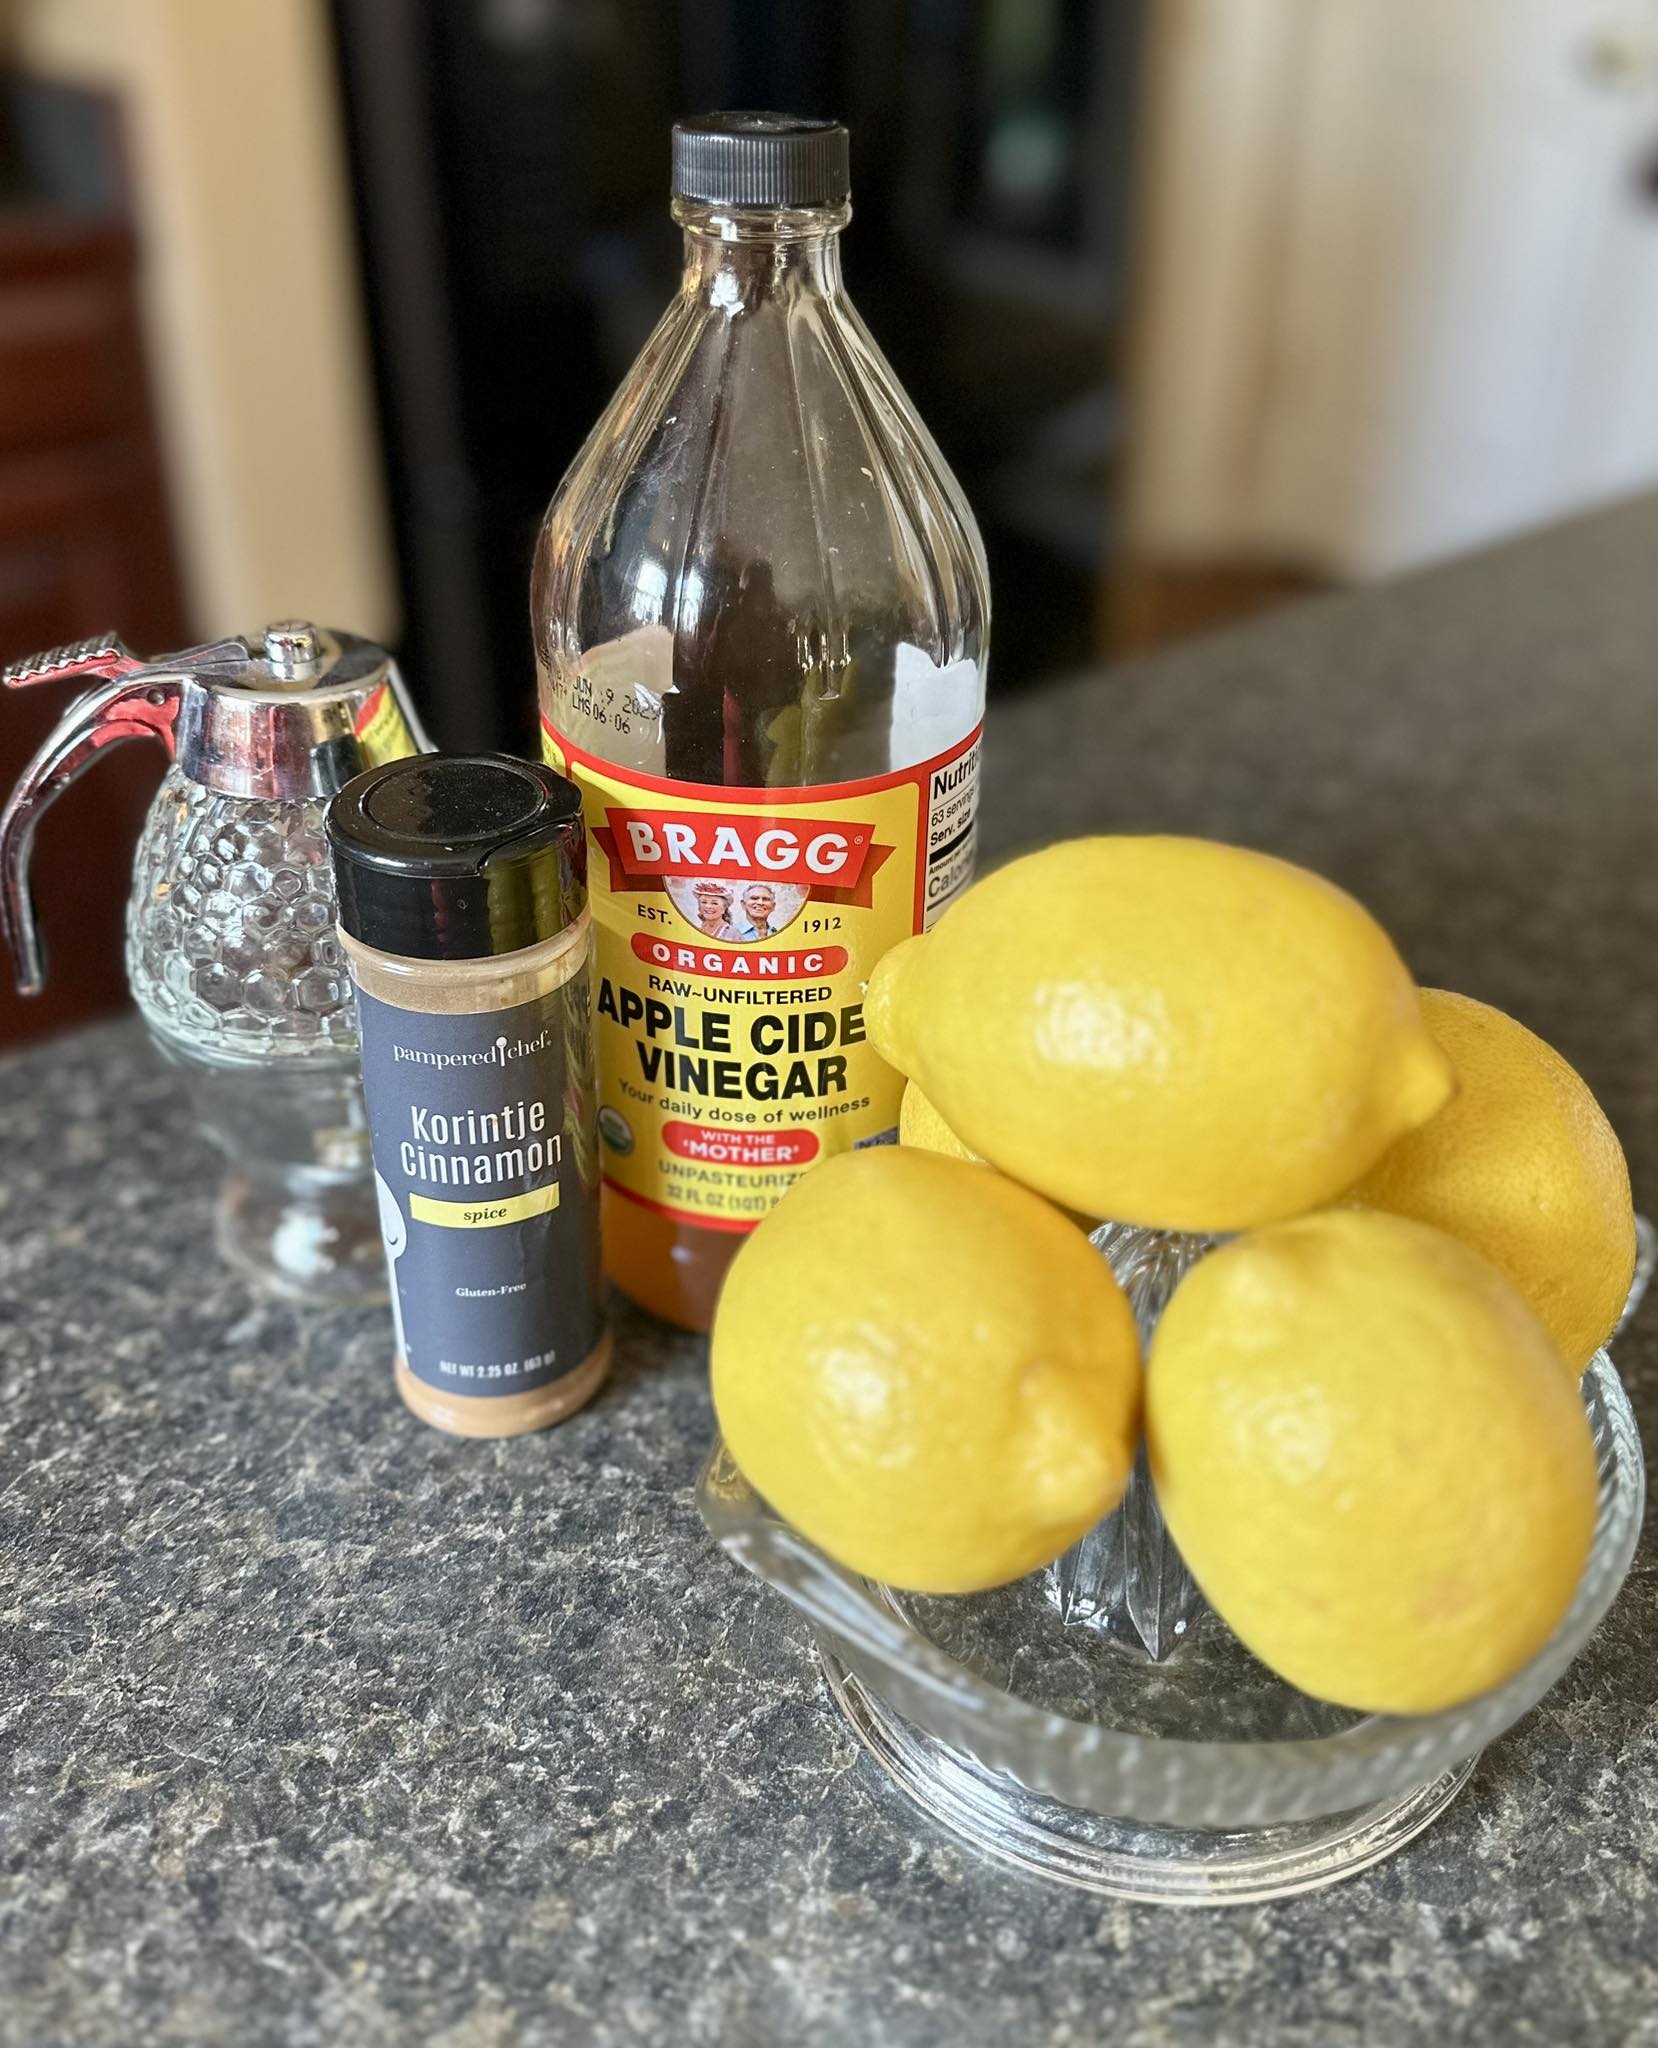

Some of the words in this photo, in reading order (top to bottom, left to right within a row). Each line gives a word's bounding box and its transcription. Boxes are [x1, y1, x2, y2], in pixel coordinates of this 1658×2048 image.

[573, 676, 592, 697] JUN
[931, 809, 945, 827] 63
[626, 820, 849, 875] BRAGG
[930, 823, 955, 847] Serv.
[637, 904, 673, 926] EST.
[803, 917, 842, 933] 1912
[652, 942, 824, 974] ORGANIC
[597, 977, 732, 1052] APPLE
[750, 1003, 867, 1056] CIDE
[636, 1040, 848, 1101] VINEGAR
[618, 1077, 654, 1104] Your
[659, 1097, 703, 1120] daily
[709, 1108, 757, 1123] dose
[764, 1108, 783, 1123] of
[790, 1096, 871, 1121] wellness
[411, 1101, 545, 1146] Korintje
[700, 1129, 743, 1145] WITH
[746, 1133, 776, 1146] THE
[400, 1134, 563, 1185] Cinnamon
[658, 1160, 808, 1188] UNPASTEURIZ
[463, 1206, 508, 1223] spice
[456, 1282, 527, 1297] Gluten-Free
[440, 1360, 457, 1375] NET
[460, 1364, 475, 1377] WT
